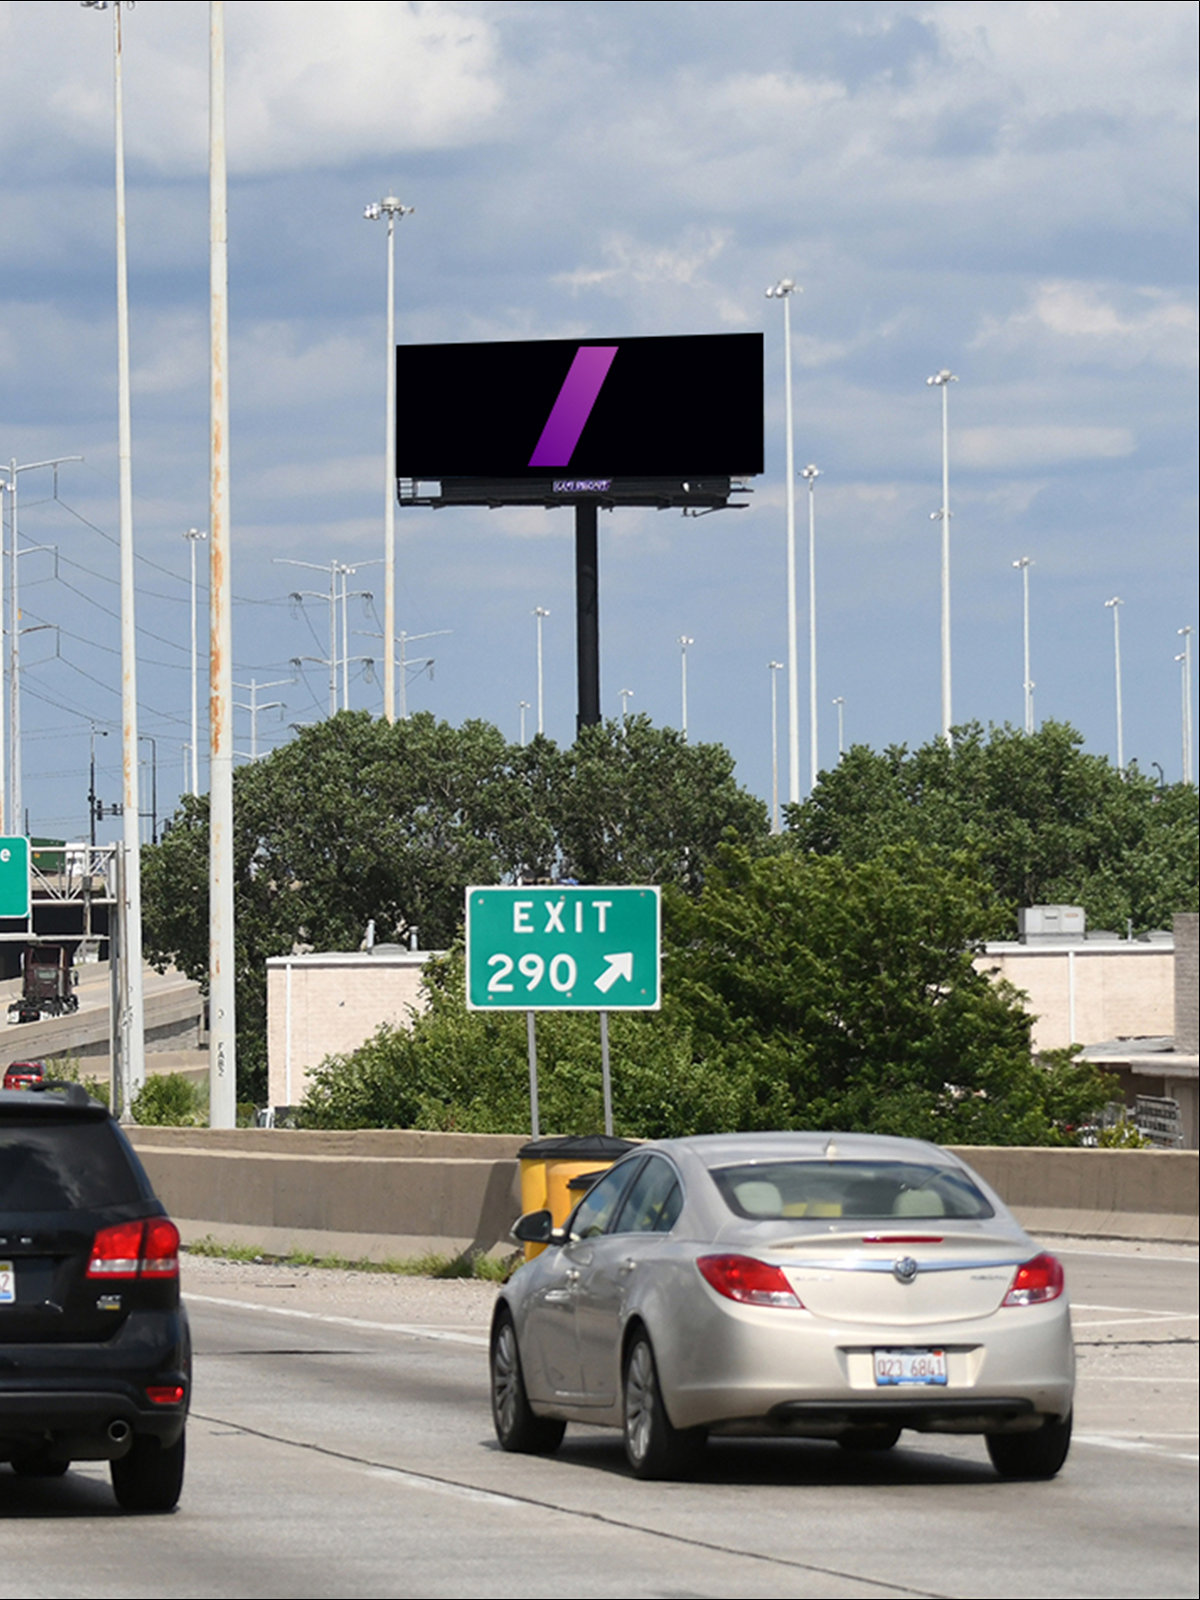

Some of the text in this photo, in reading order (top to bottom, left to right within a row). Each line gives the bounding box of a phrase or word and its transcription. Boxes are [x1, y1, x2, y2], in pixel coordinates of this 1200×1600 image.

[513, 901, 612, 933] EXIT
[487, 953, 577, 992] 290
[911, 1359, 944, 1376] 6841
